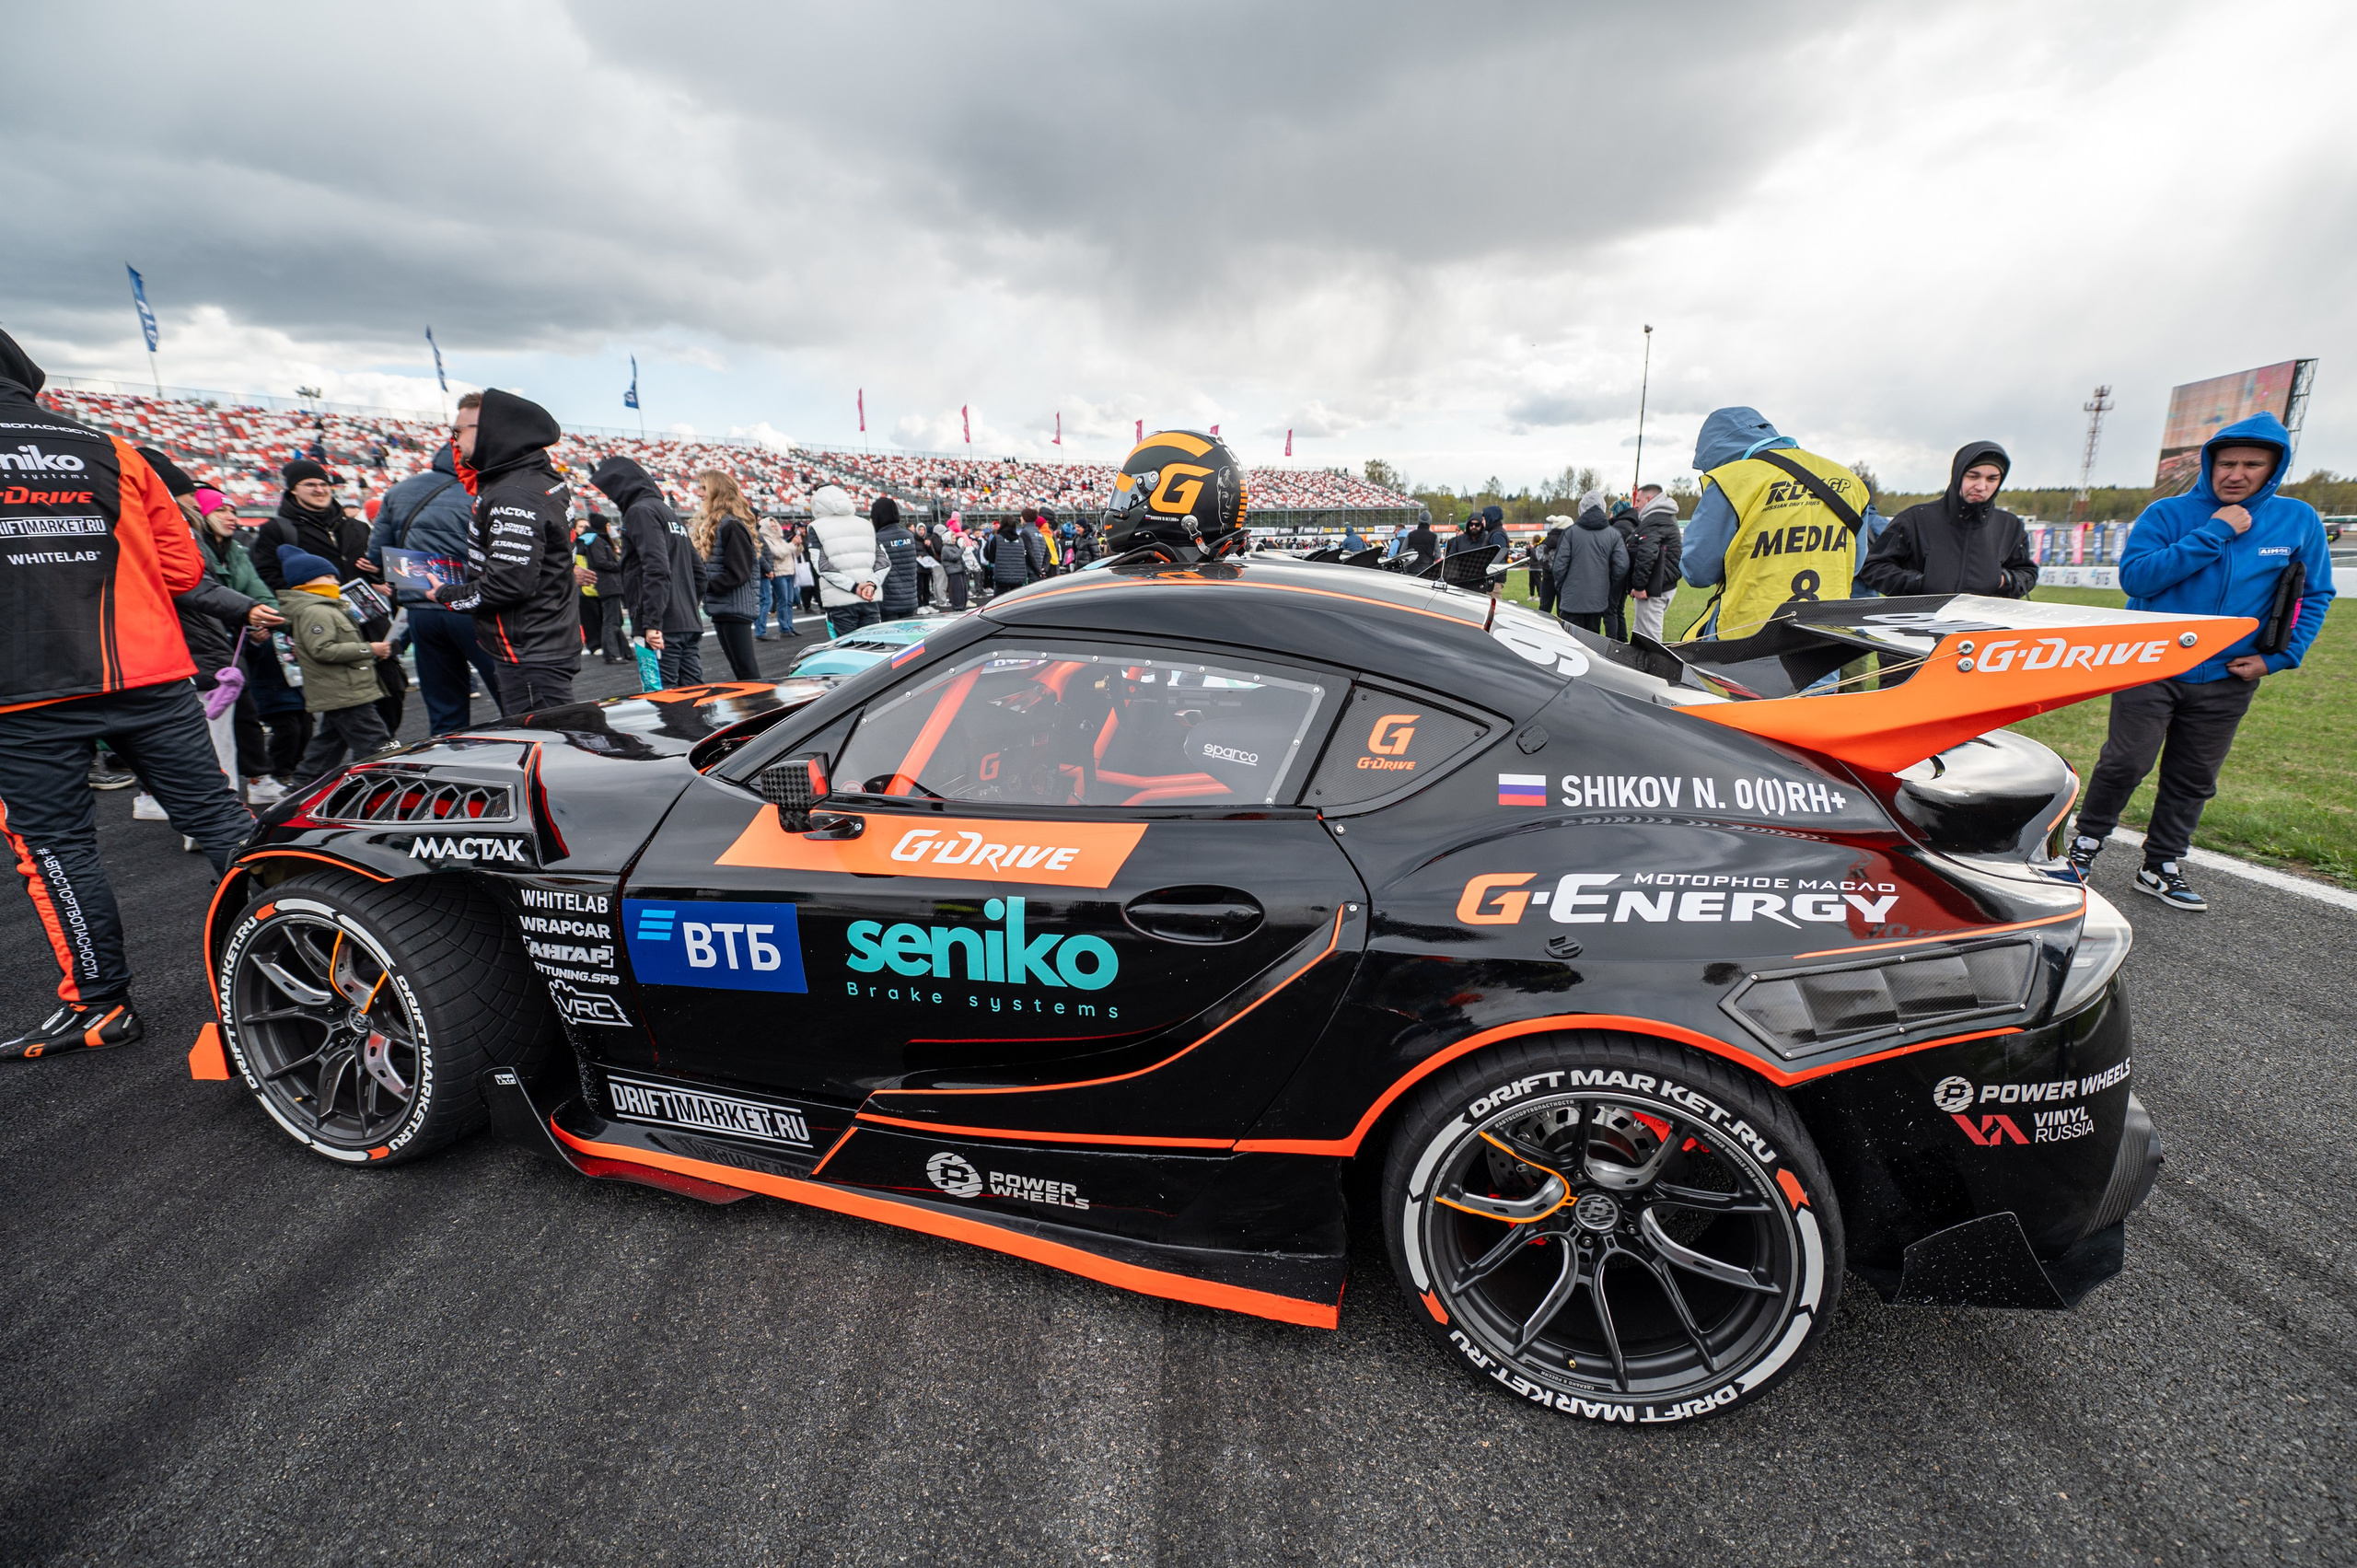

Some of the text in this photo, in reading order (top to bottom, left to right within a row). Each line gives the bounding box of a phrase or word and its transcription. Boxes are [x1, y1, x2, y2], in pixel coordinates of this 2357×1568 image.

[0, 445, 85, 471] niko
[890, 539, 911, 547] LECAR
[1749, 525, 1848, 559] MEDIA
[1202, 742, 1259, 765] sparco
[1560, 775, 1681, 808] SHIKOV
[1692, 777, 1726, 808] N.
[1633, 873, 1897, 893] МОТОРНОЕ МАСЛО
[520, 889, 609, 914] WHITELAB
[518, 915, 612, 939] WRAPCAR
[682, 922, 782, 972] ВТБ
[846, 895, 1120, 991] seniko
[557, 995, 615, 1019] VRC
[847, 981, 1120, 1019] Brake systems
[1979, 1080, 2077, 1104] POWER
[2081, 1056, 2131, 1097] WHEELS
[2034, 1106, 2090, 1128] VINYL
[2035, 1119, 2095, 1144] RUSSIA
[989, 1170, 1077, 1197] POWER
[989, 1182, 1090, 1211] WHEELS
